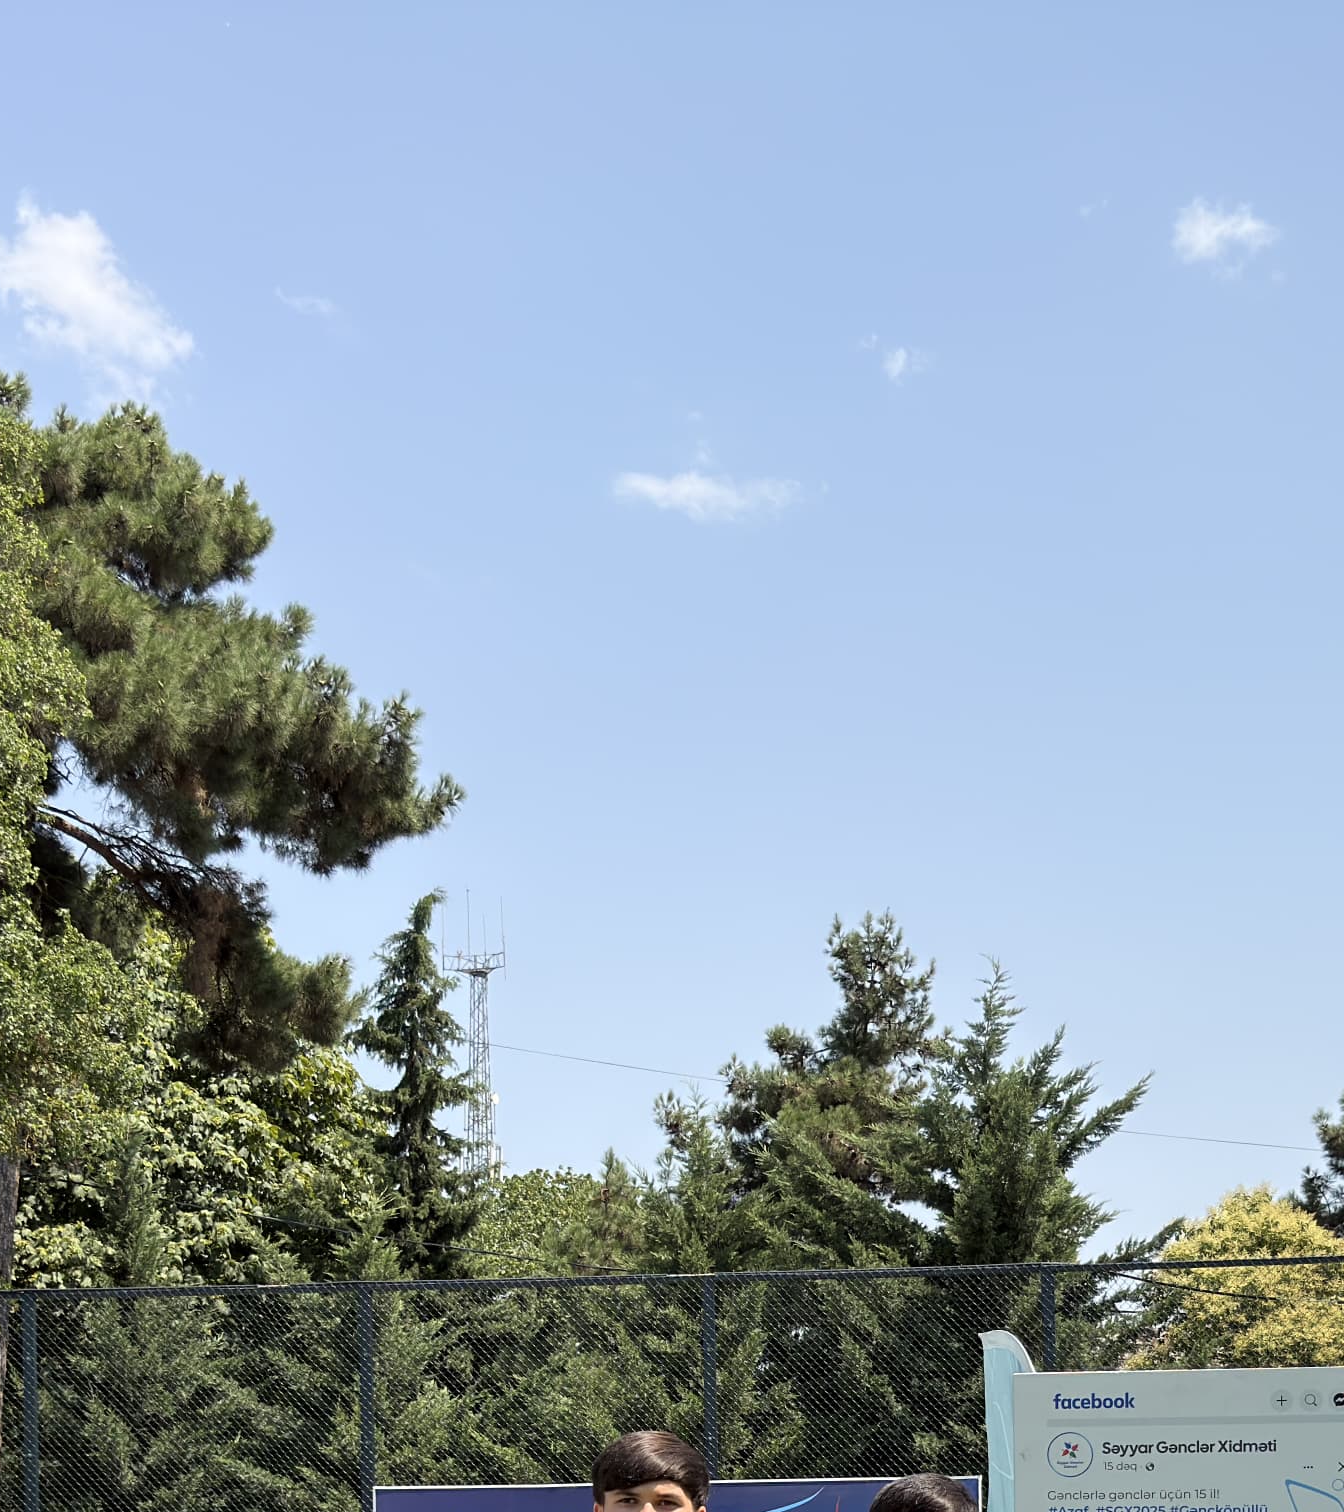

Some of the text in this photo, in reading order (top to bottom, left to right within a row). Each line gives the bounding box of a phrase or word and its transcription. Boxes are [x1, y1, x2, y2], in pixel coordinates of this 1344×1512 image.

[1053, 1392, 1136, 1410] facebook
[1102, 1439, 1277, 1456] Səyyar Gənclər Xidməti
[1047, 1489, 1220, 1504] Gənclərlə gənclər üçün 15 il!
